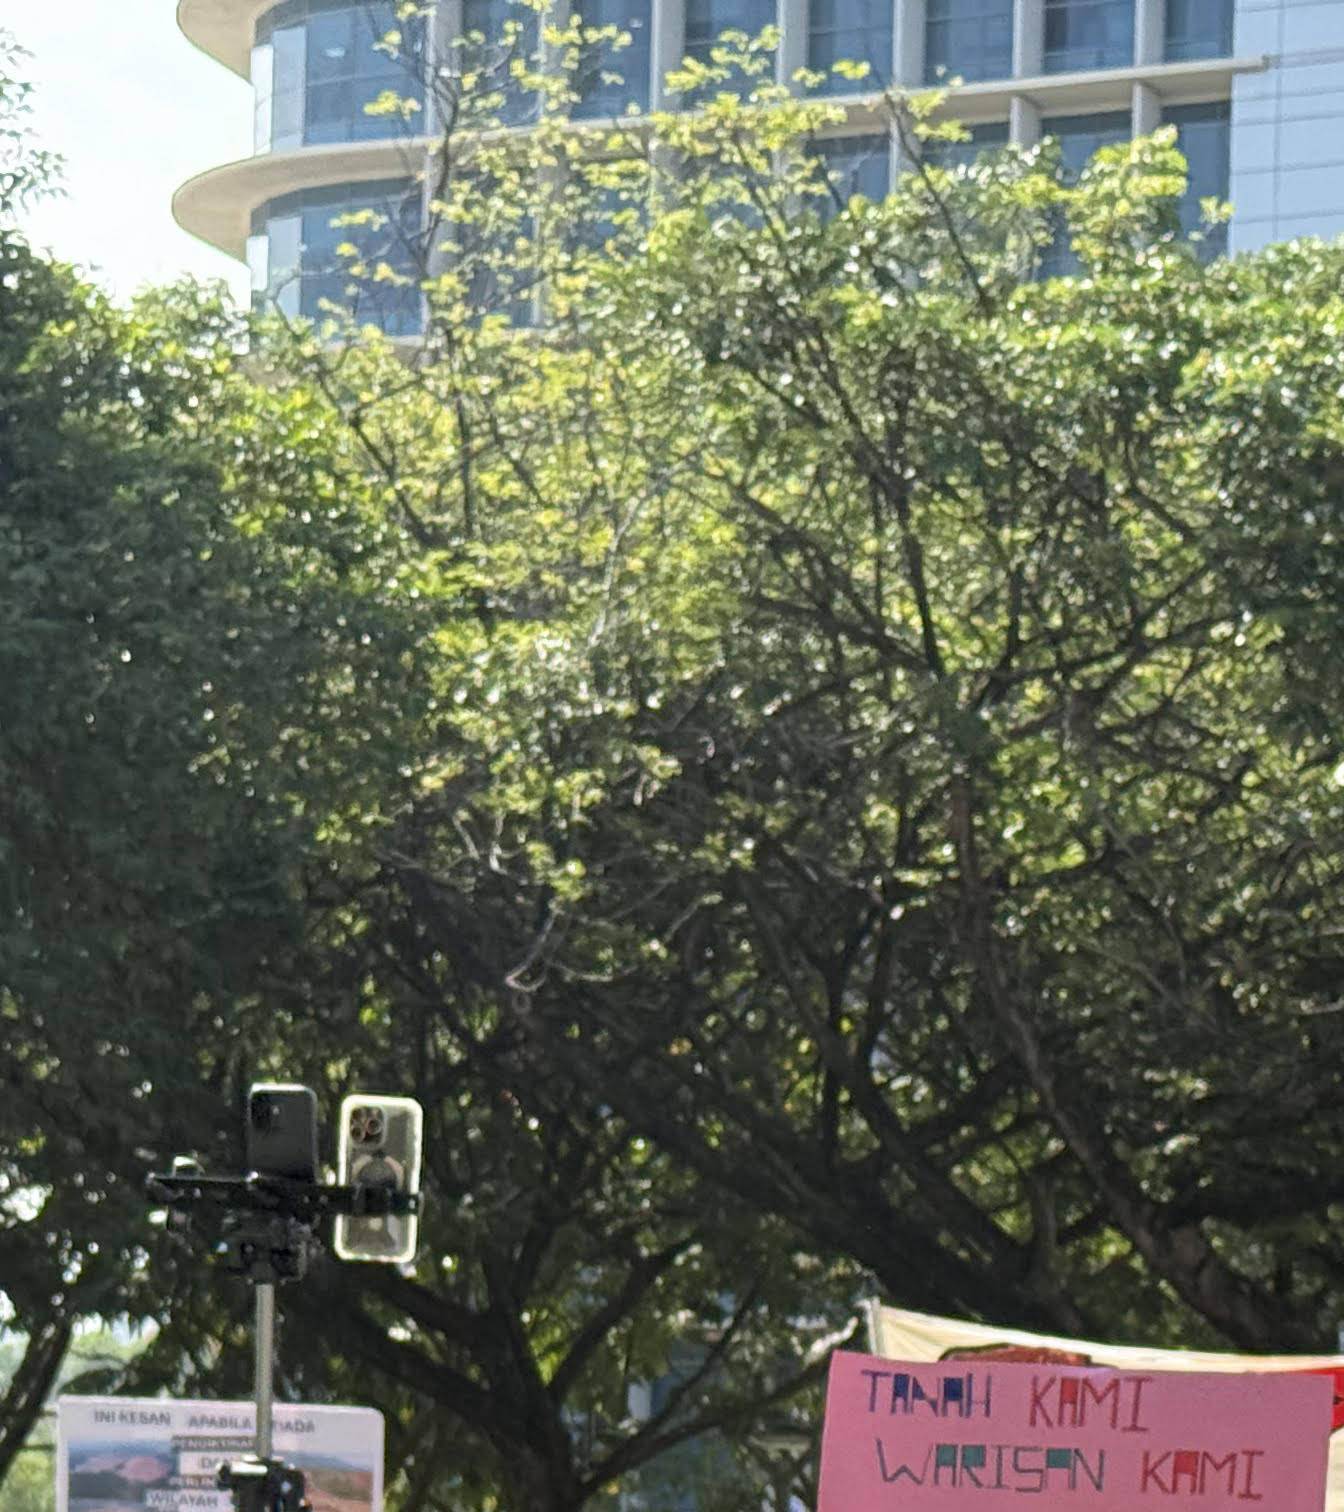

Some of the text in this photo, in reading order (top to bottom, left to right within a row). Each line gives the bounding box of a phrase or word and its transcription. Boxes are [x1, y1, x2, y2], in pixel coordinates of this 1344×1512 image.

[862, 1369, 1153, 1432] TANAH KAMI
[876, 1438, 1265, 1499] WARISAN KAMI
